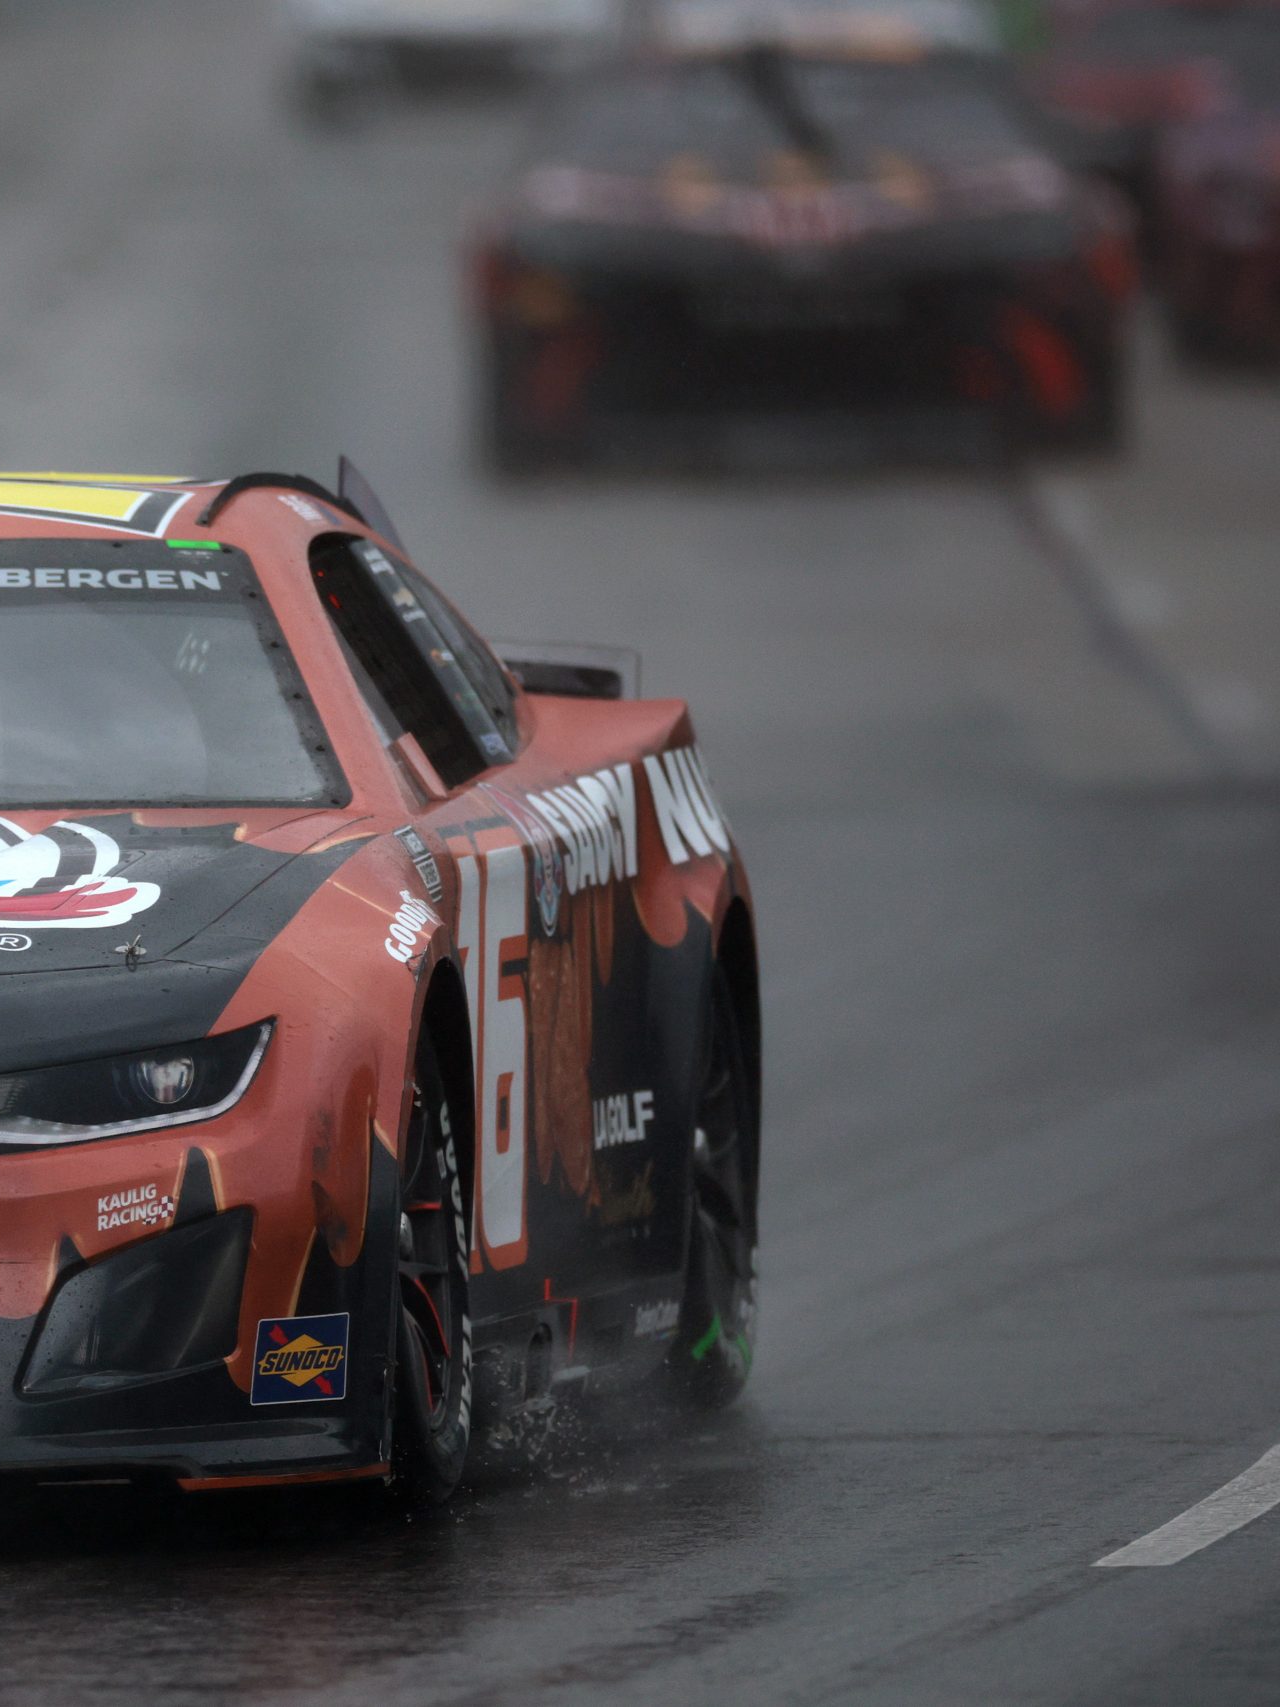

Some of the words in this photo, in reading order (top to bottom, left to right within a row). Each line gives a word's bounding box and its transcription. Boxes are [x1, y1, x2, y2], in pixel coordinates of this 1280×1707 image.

[526, 762, 639, 896] SAUCY
[455, 840, 528, 1256] 16
[97, 1183, 157, 1214] KAULIG
[97, 1200, 159, 1232] RACING
[260, 1346, 342, 1373] SUNOCO
